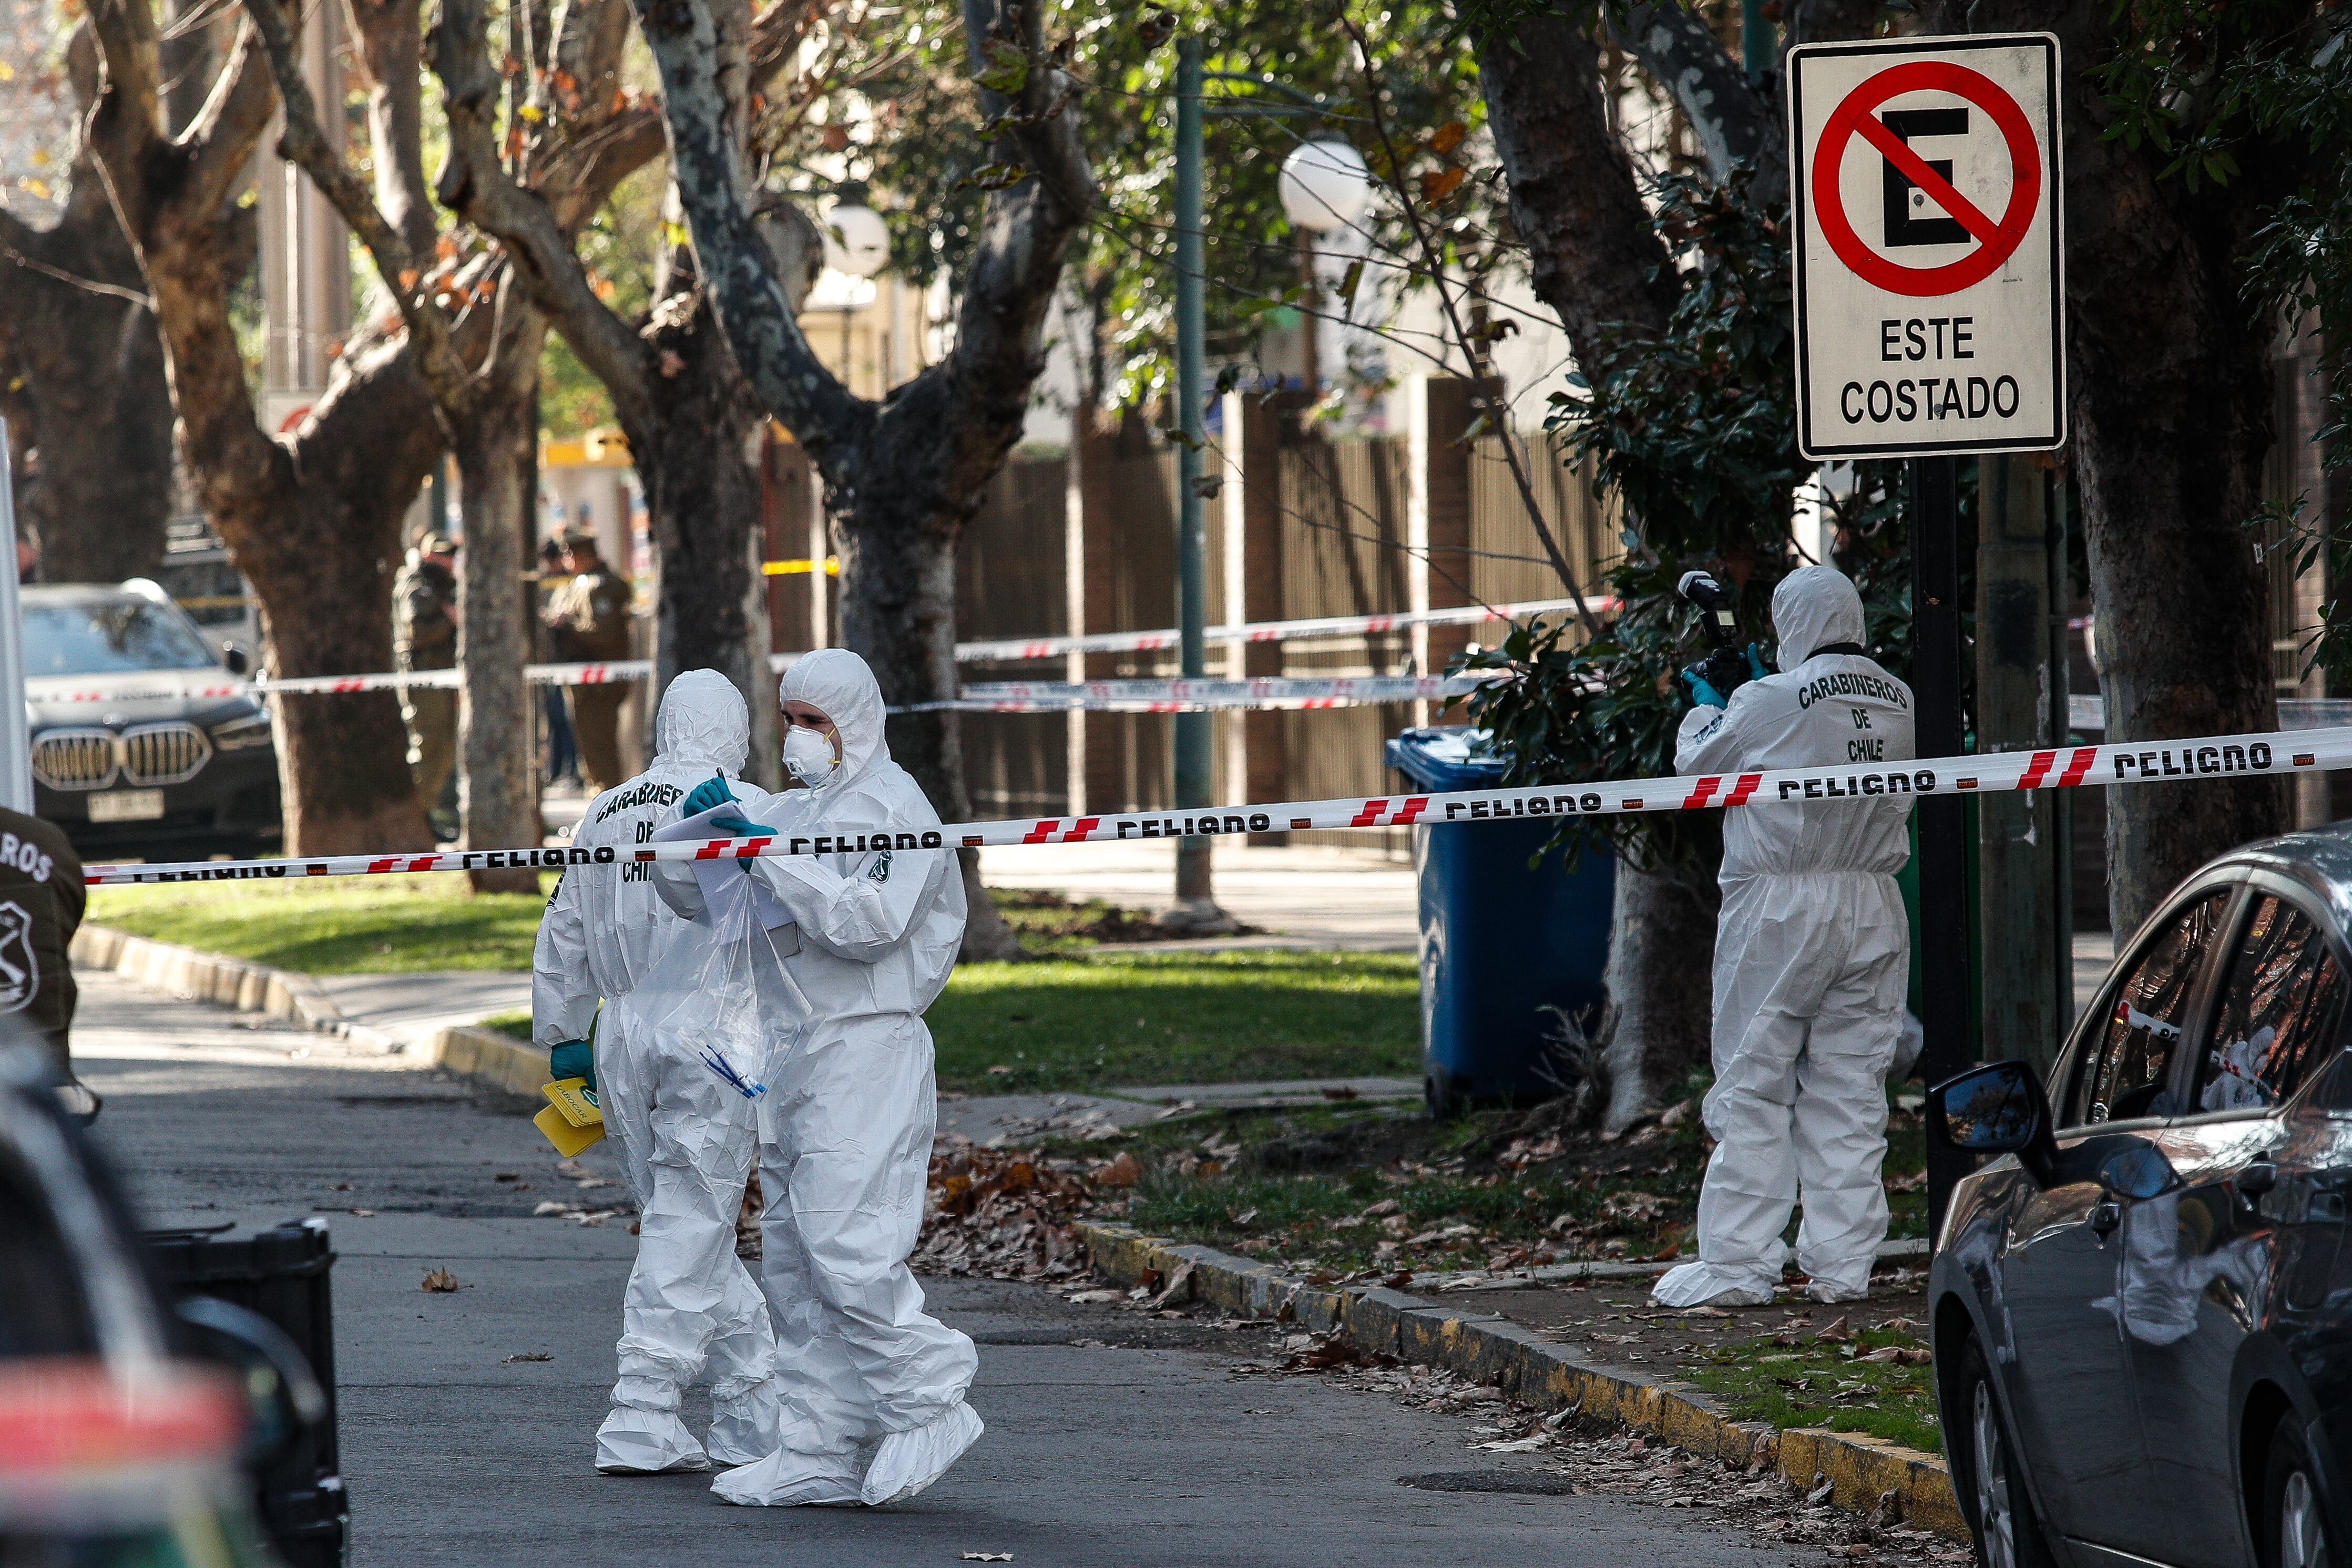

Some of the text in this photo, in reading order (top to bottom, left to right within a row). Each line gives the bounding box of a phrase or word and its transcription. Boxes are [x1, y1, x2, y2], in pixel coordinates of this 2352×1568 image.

[1880, 316, 1975, 363] ESTE
[1840, 374, 2020, 425] COSTADO
[1798, 673, 1909, 710] CARABINEROS
[1850, 708, 1873, 730] DE
[1847, 738, 1884, 762] CHILE
[2113, 741, 2273, 780] PELIGRO
[1778, 769, 1937, 800] PELIGRO
[622, 862, 652, 883] CHI
[556, 1084, 588, 1119] LABOCAR
